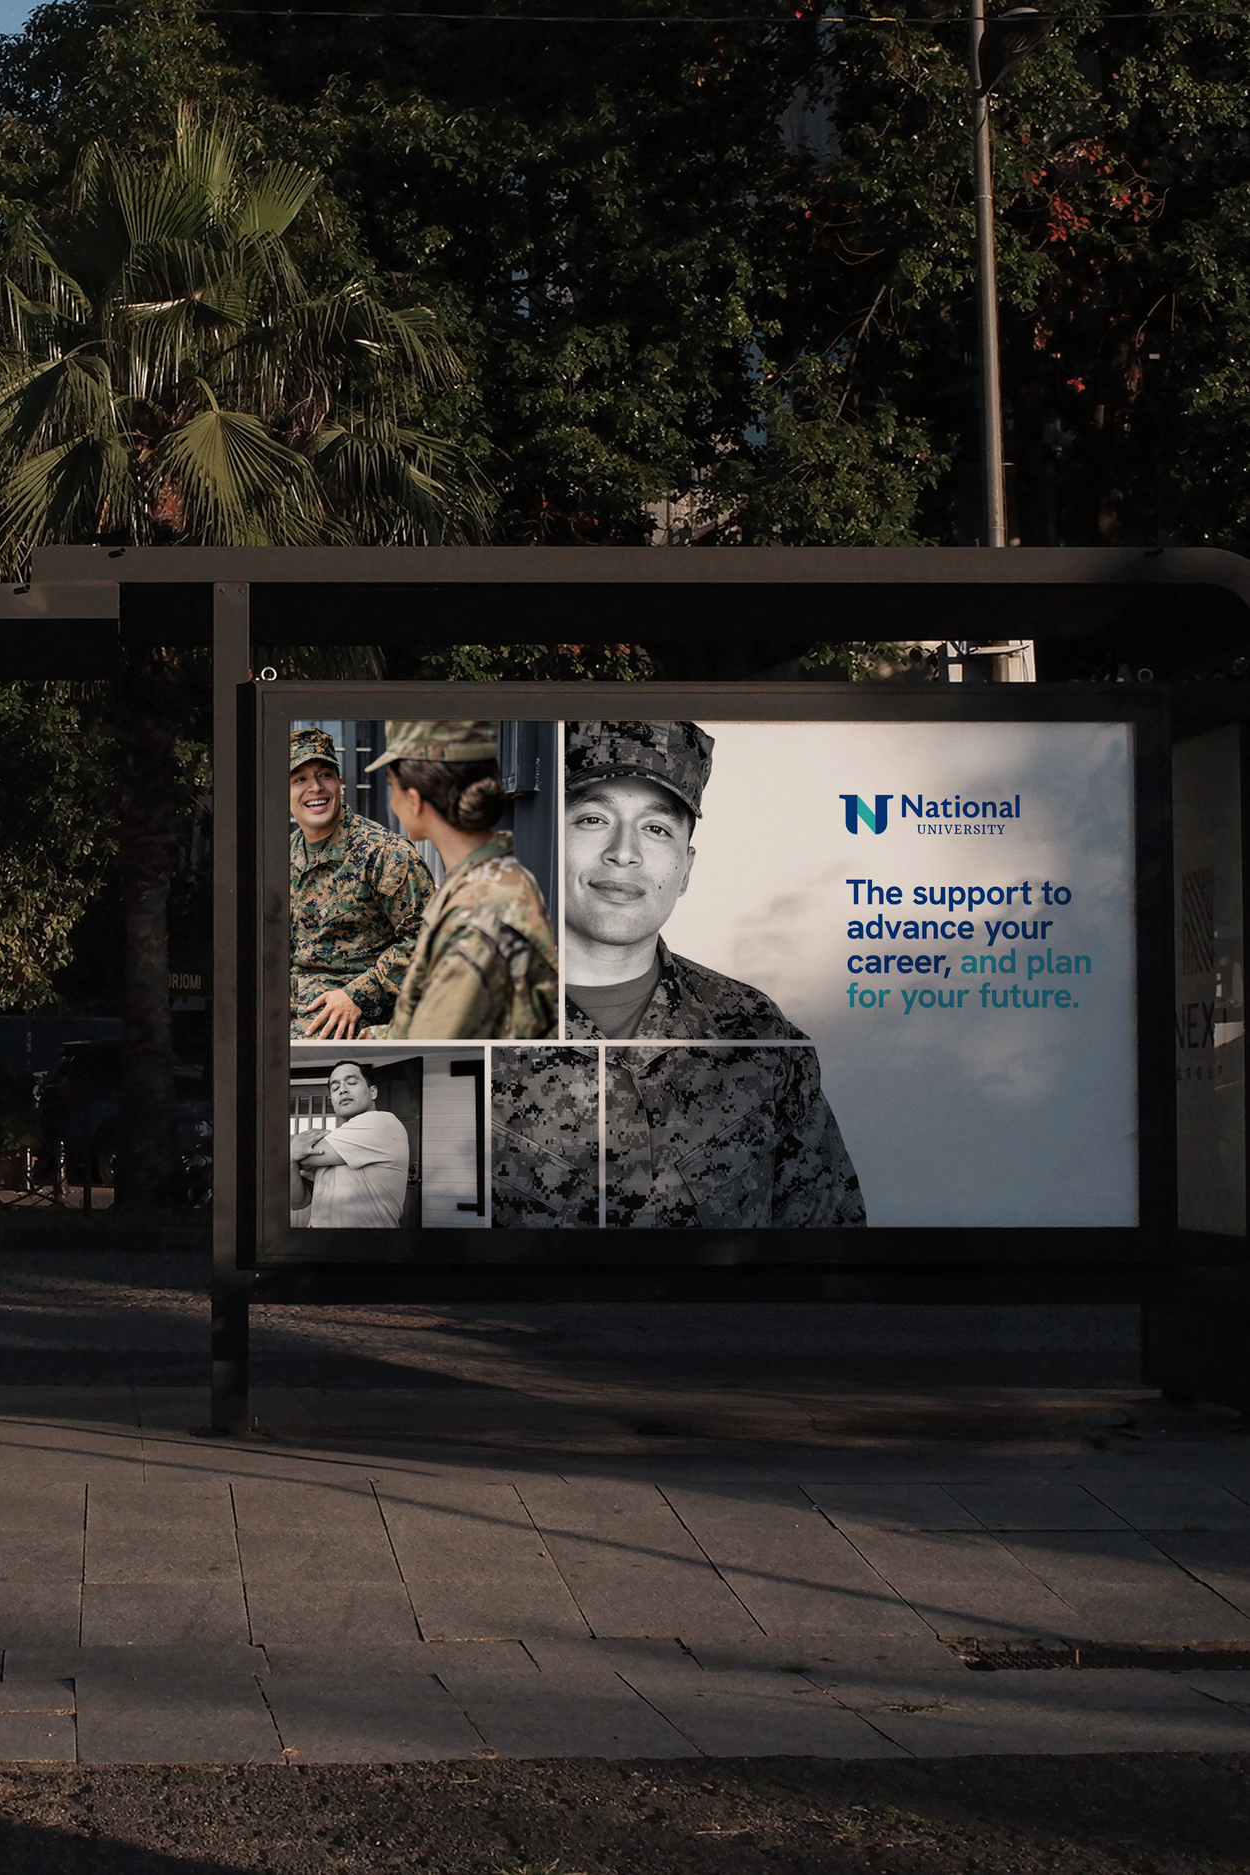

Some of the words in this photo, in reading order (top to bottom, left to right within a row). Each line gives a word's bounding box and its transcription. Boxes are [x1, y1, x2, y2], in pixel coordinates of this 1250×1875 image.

[902, 795, 1020, 818] National
[918, 825, 1005, 834] UNIVERSITY
[846, 880, 902, 905] The
[913, 881, 1032, 912] support
[1041, 881, 1072, 905] to
[847, 914, 974, 939] advance
[985, 921, 1053, 946] your
[848, 955, 951, 979] career,
[961, 948, 1016, 974] and
[1028, 948, 1091, 980] plan
[847, 982, 891, 1008] for
[901, 990, 970, 1015] your
[979, 982, 1078, 1008] future.
